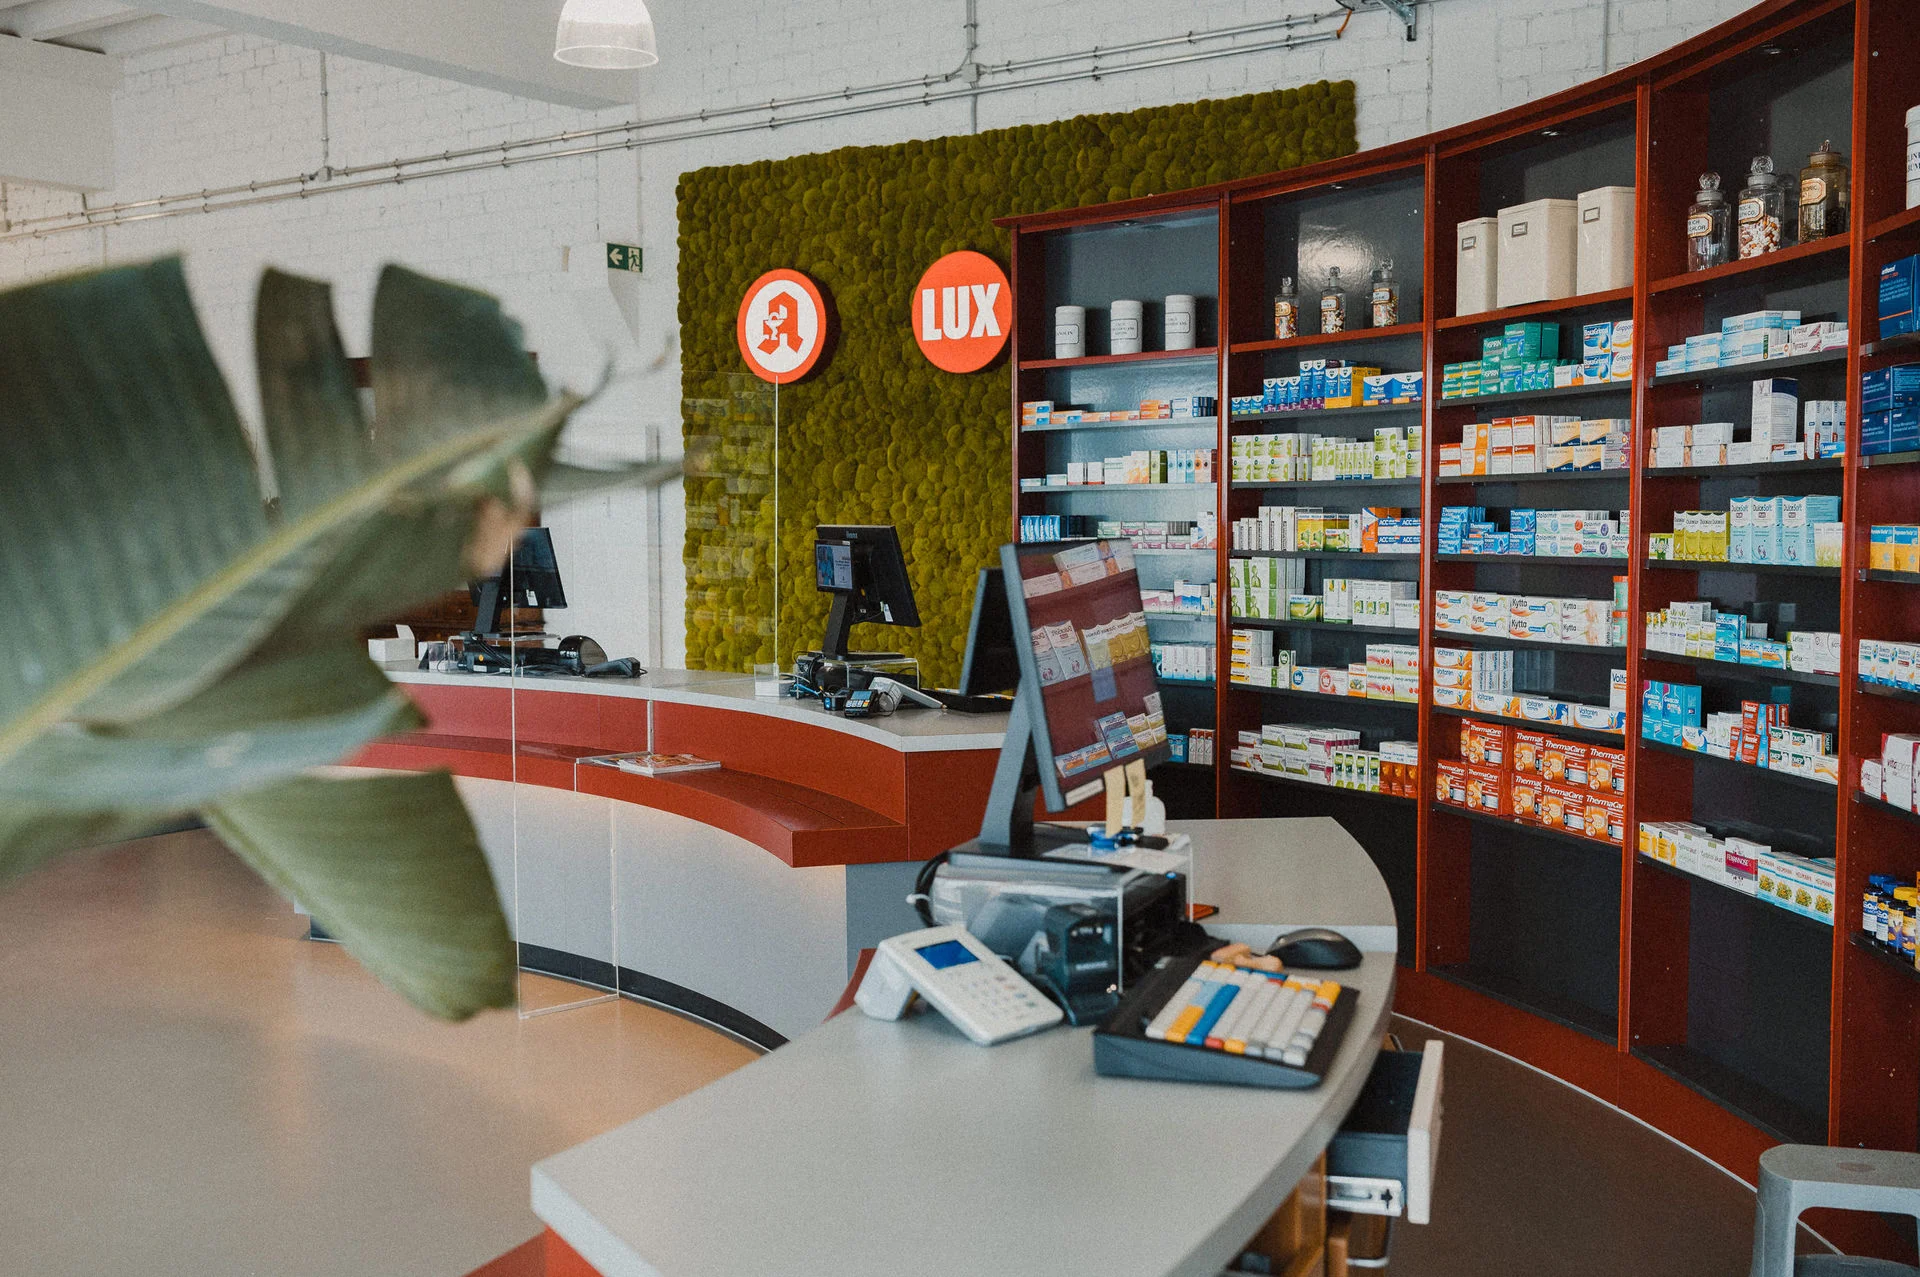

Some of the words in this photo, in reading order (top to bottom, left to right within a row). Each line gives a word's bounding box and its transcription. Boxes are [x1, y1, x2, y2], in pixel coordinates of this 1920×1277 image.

[921, 282, 1001, 342] LUX
[1437, 592, 1449, 601] Kytta
[1473, 596, 1486, 604] Kytta
[1512, 598, 1528, 608] Kytta
[1563, 602, 1576, 610] Kytta
[1436, 612, 1448, 620] Kytta
[1472, 616, 1484, 624] Kytta
[1511, 620, 1528, 630] Kytta
[1563, 624, 1576, 632] Kytta
[1476, 693, 1495, 701] Voltaren
[1525, 700, 1544, 708] Voltaren
[1578, 707, 1599, 716] Voltaren
[1470, 724, 1502, 736] ThermaCare
[1545, 740, 1586, 754] ThermaCare
[1437, 762, 1465, 773] ThermaCare
[1468, 769, 1498, 780] ThermaCare
[1543, 784, 1584, 800] ThermaCare
